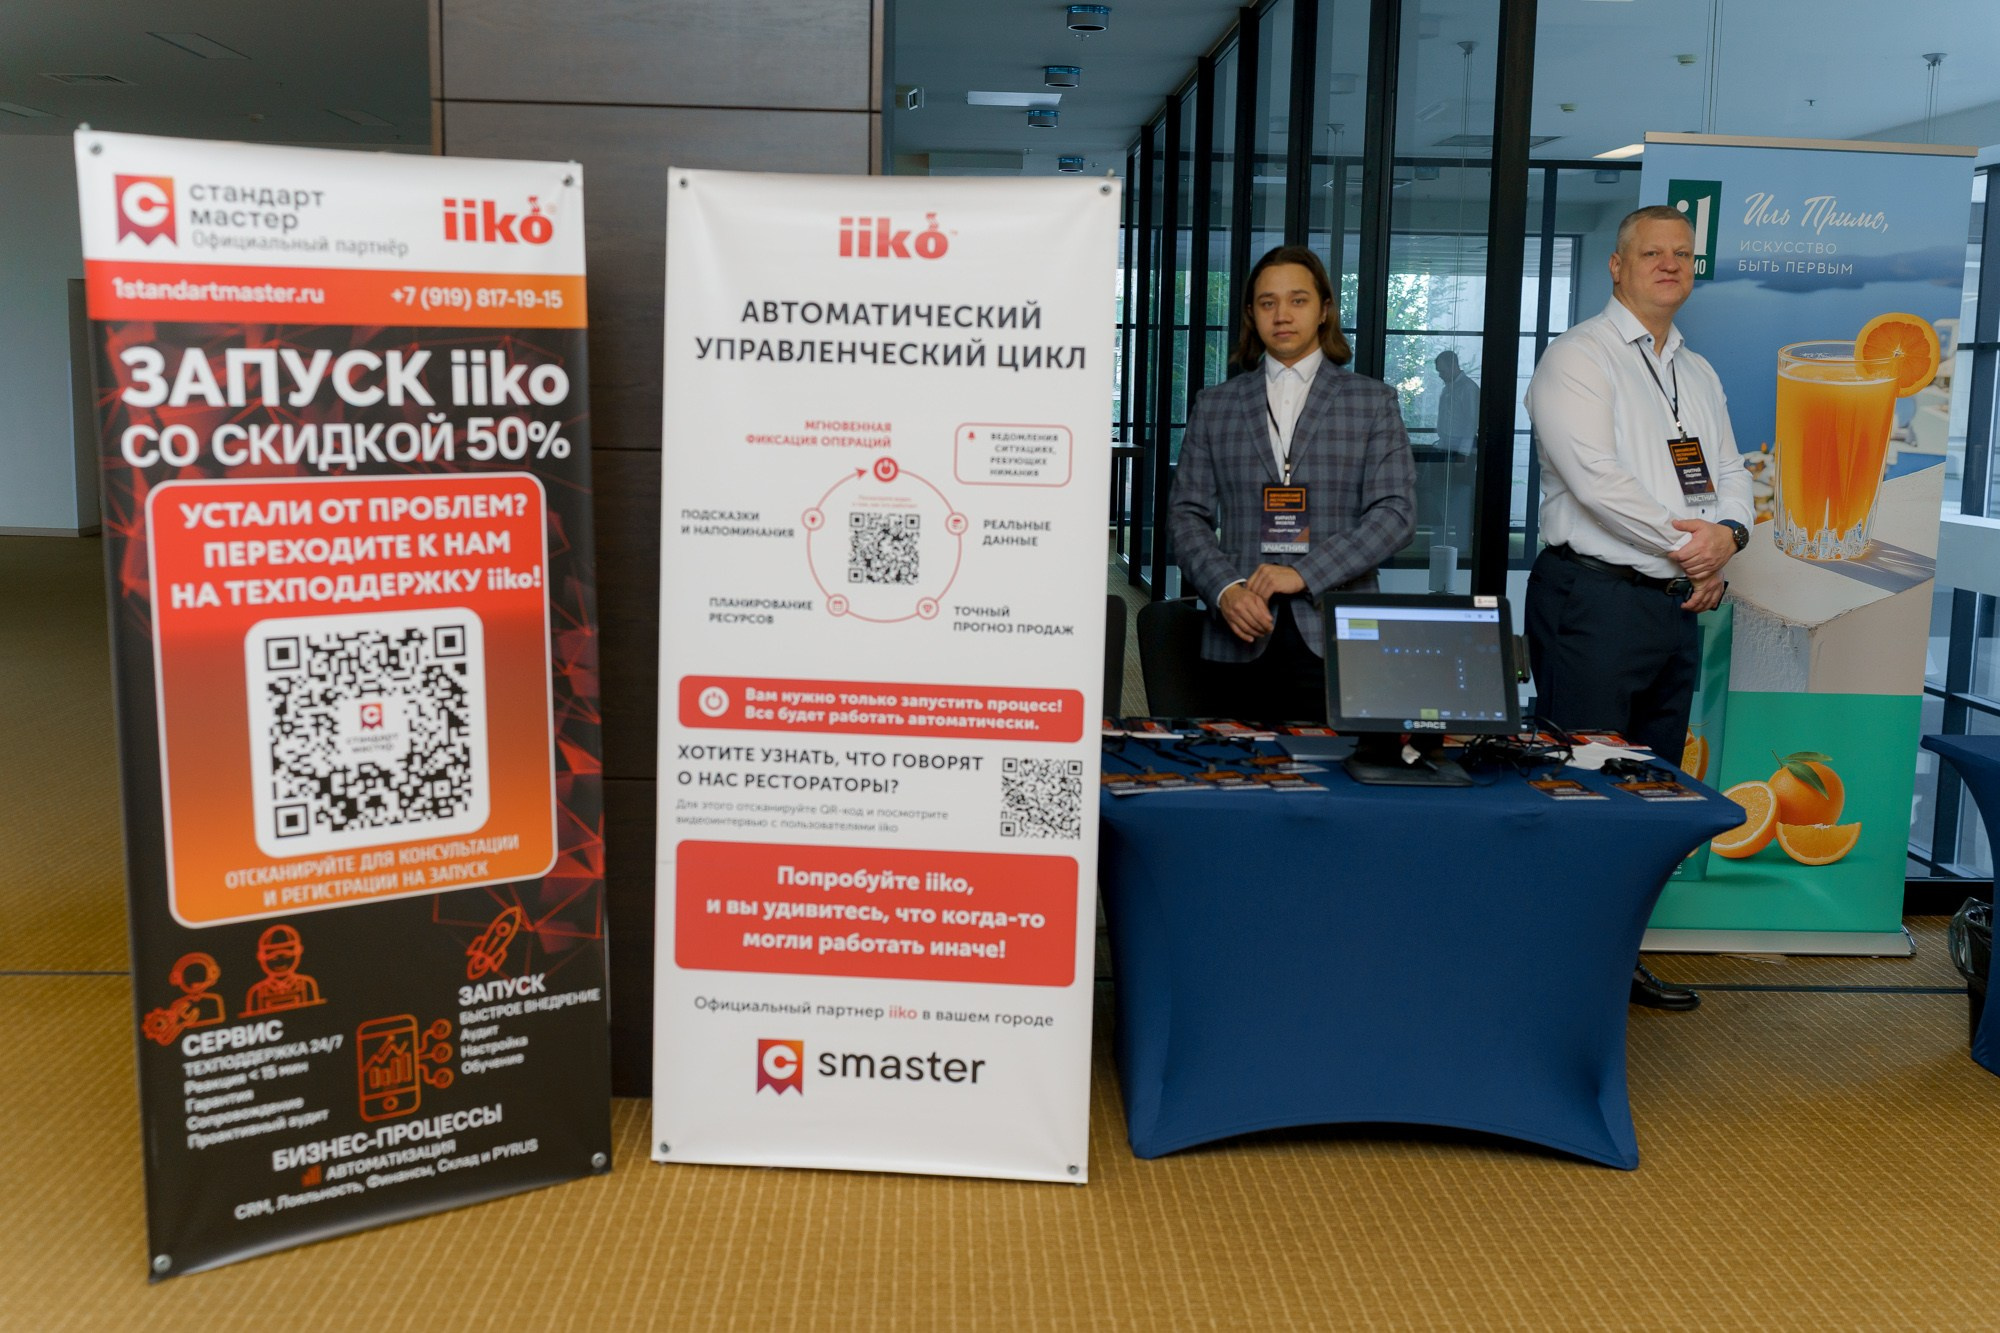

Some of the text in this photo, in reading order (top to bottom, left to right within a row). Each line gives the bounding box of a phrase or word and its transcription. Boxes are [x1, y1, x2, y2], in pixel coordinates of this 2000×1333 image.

[190, 182, 325, 208] стандарт
[191, 207, 299, 234] мастер
[443, 196, 554, 244] iiko
[1743, 192, 1889, 236] Иль Примо,
[192, 230, 409, 258] Официальный партнёр
[839, 212, 949, 259] iiko
[1740, 240, 1837, 255] ИСКУССТВО
[1738, 259, 1853, 275] БЫТЬ ПЕРВЫМ
[112, 276, 325, 304] 1standartmaster.ru
[391, 286, 563, 312] +7 (919) 817-19-15
[742, 300, 1042, 329] АВТОМАТИЧЕСКИЙ
[695, 336, 1086, 372] УПРАВЛЕНЧЕСКИЙ ЦИКЛ
[120, 346, 570, 408] ЗАПУСК iiko
[804, 420, 892, 433] МГНОВЕННАЯ
[120, 414, 571, 471] СО СКИДКОЙ 50%
[745, 433, 891, 449] ФИКСАЦИЯ ОПЕРАЦИЙ
[179, 493, 529, 529] УСТАЛИ ОТ ПРОБЛЕМ?
[681, 509, 760, 522] ПОДСКАЗКИ
[983, 518, 1052, 531] РЕАЛЬНЫЕ
[681, 524, 795, 539] И НАПОМИНАНИЯ
[982, 534, 1039, 547] ДАННЫЕ
[204, 531, 512, 568] ПЕРЕХОДИТЕ К НАМ
[1263, 544, 1306, 553] УЧАСТНИК
[171, 565, 541, 609] НА ТЕХПОДДЕРЖКУ iiko!
[709, 597, 814, 611] ПЛАНИРОВАНИЕ
[953, 603, 1010, 617] ТОЧНЫЙ
[709, 612, 775, 625] РЕСУРСОВ
[953, 621, 1074, 637] ПРОГНОЗ ПРОДАЖ
[745, 687, 1063, 716] Вам нужно только запустить процесс!
[745, 705, 1040, 732] Все будет работать автоматически.
[1413, 721, 1446, 729] SPACE
[678, 745, 984, 771] ХОТИТЕ УЗНАТЬ, ЧТО ГОВОРЯТ
[678, 772, 899, 794] О НАС РЕСТОРАТОРЫ?
[225, 834, 519, 889] ОТСКАНИРУЙТЕ ДЛЯ КОНСУЛЬТАЦИИ
[263, 860, 490, 907] И РЕГИСТРАЦИИ НА ЗАПУСК
[777, 866, 974, 895] Попробуйте iiko,
[706, 900, 1046, 928] и вы удивитесь, что когда-то
[743, 932, 1006, 959] могли работать иначе!
[458, 973, 546, 1006] ЗАПУСК
[459, 988, 601, 1025] БЫСТРОЕ ВНЕДРЕНИЕ
[694, 996, 1055, 1028] Официальный партнер iiko в вашем городе
[182, 1020, 284, 1057] СЕРВИС
[460, 1025, 500, 1043] Аудит
[460, 1035, 529, 1058] Настройка
[183, 1034, 344, 1077] ТЕХПОДДЕРЖКА 24/7
[461, 1053, 525, 1075] Обучение
[817, 1050, 986, 1085] smaster
[272, 1104, 502, 1172] БИЗНЕС-ПРОЦЕССЫ
[326, 1139, 456, 1181] АВТОМАТИЗАЦИЯ
[365, 1165, 435, 1192] Финансы,
[437, 1154, 480, 1175] Склад
[480, 1151, 490, 1164] и
[492, 1139, 539, 1161] PYRUS
